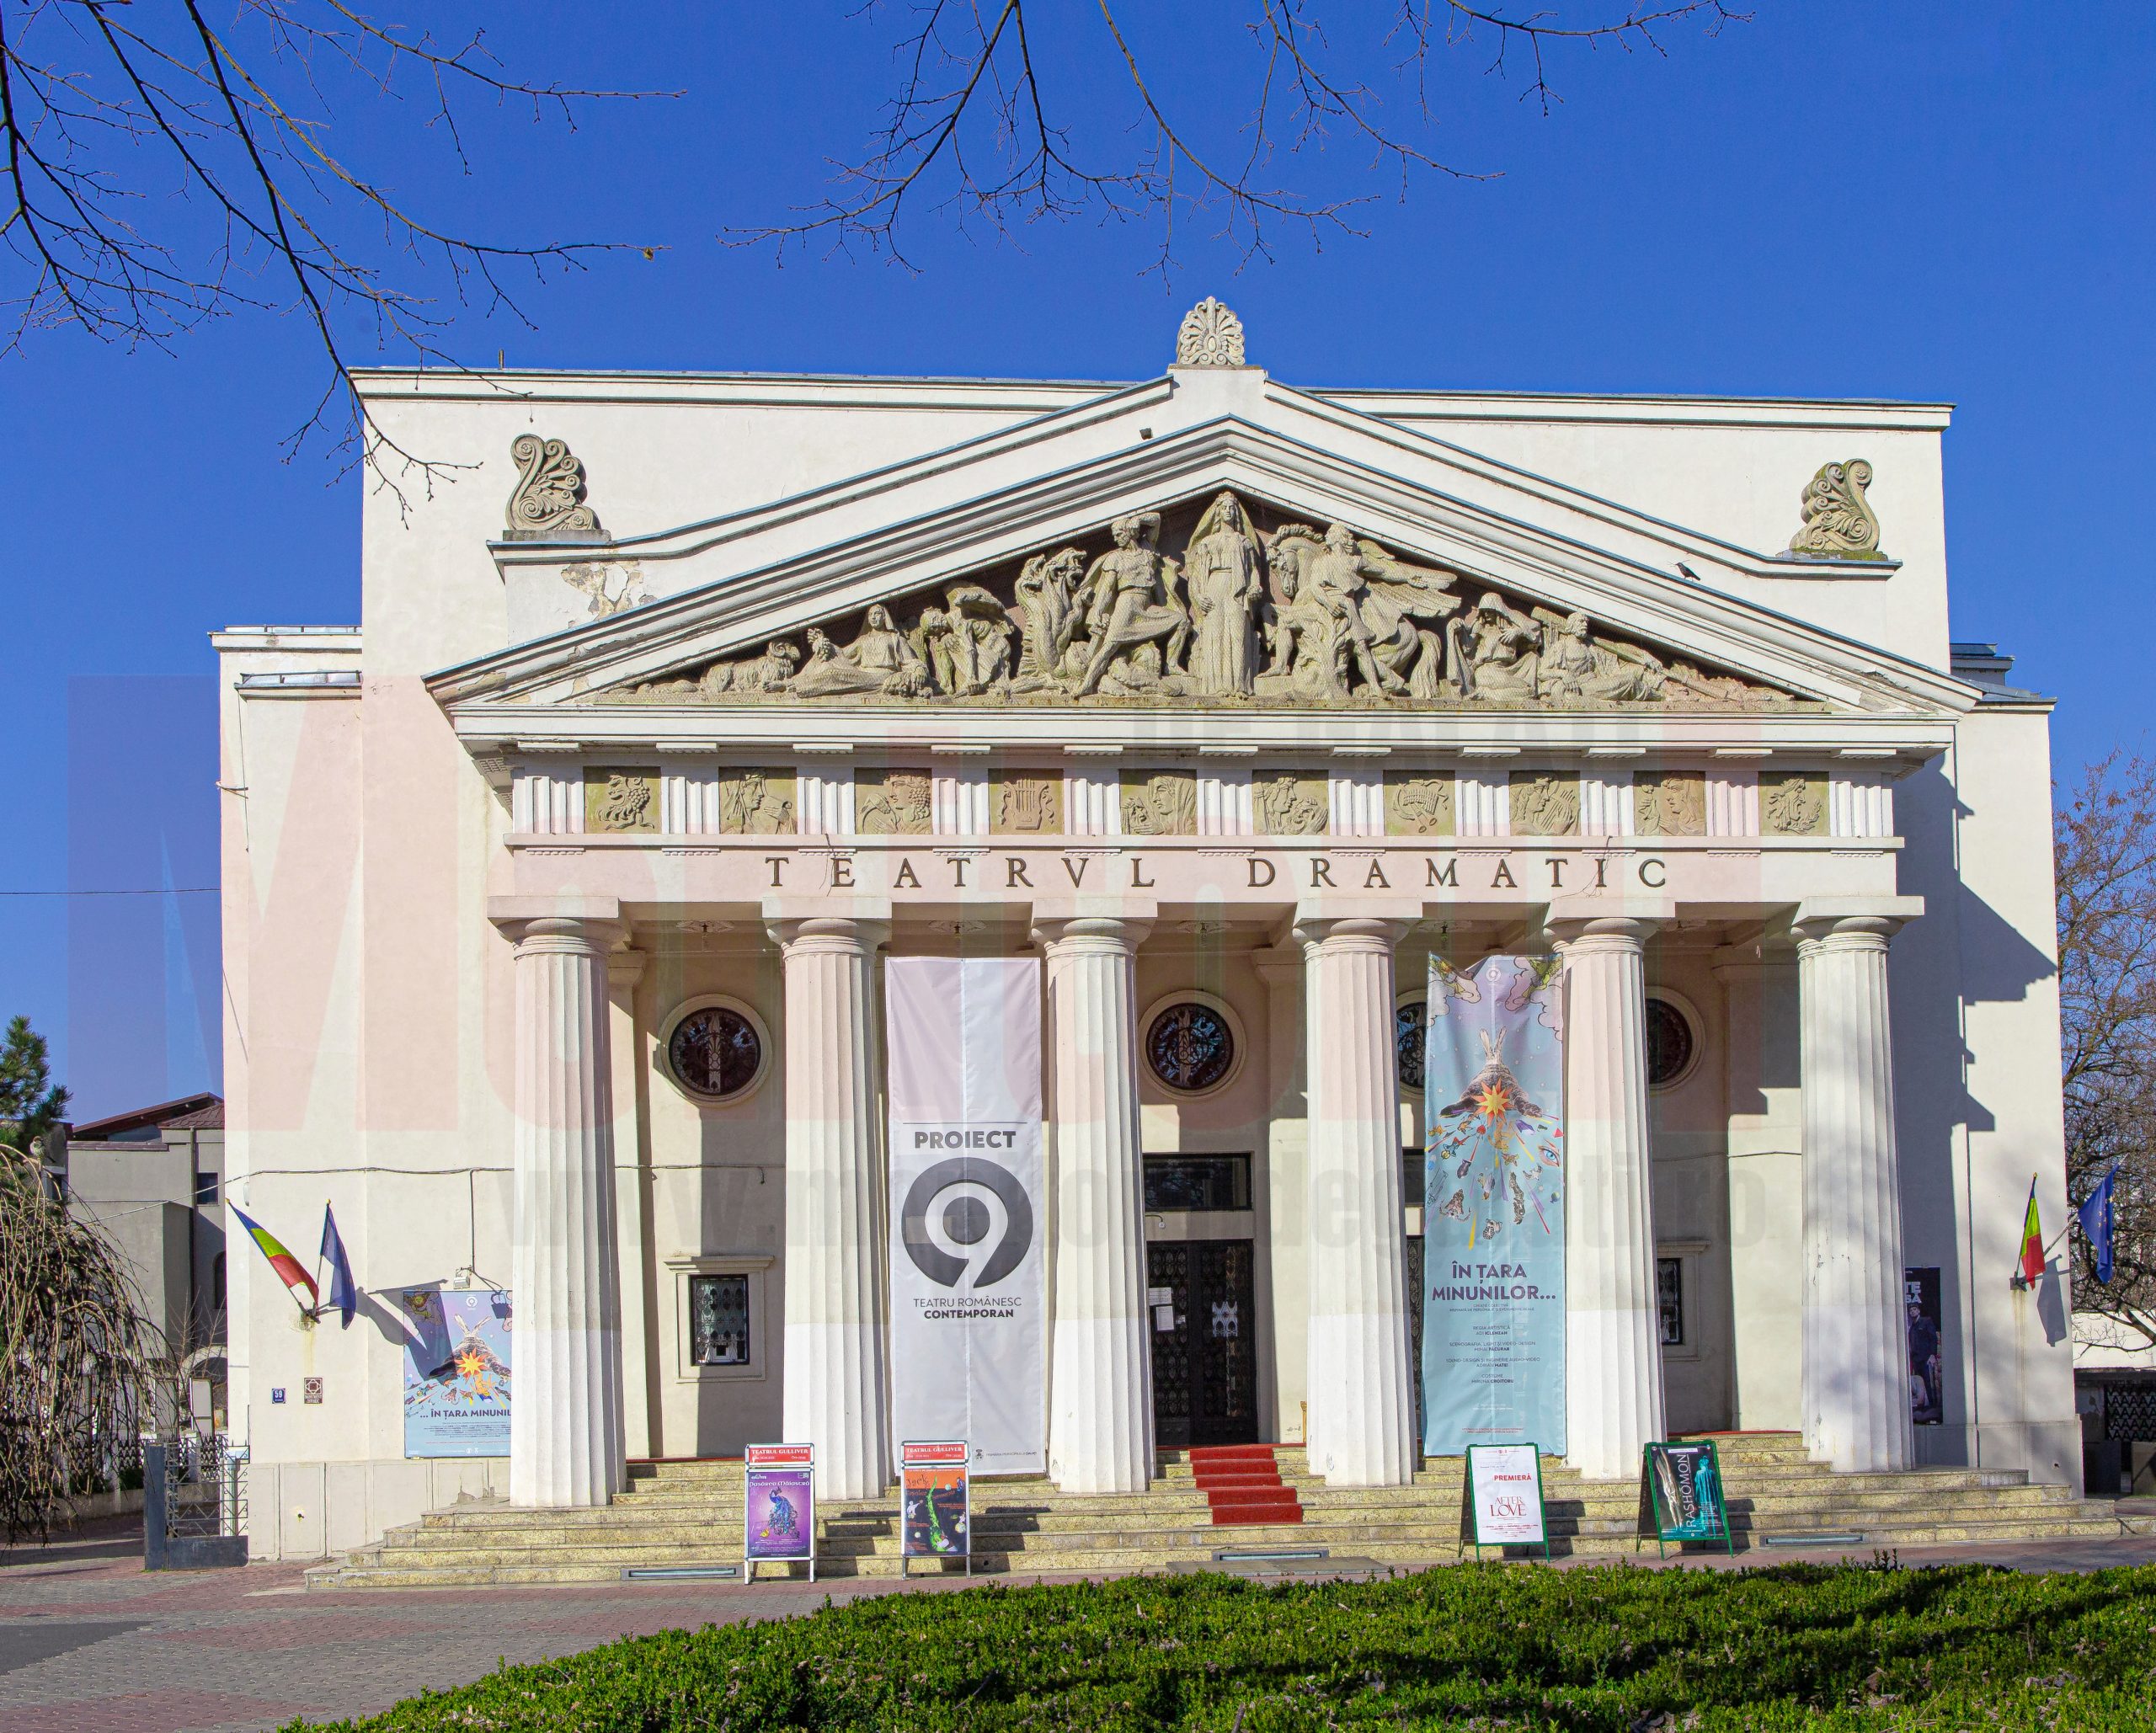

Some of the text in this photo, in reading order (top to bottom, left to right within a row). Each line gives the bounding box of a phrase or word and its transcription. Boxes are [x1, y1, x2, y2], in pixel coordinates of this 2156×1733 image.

[765, 856, 1667, 889] TEATRVL DRAMATIC
[915, 1130, 1017, 1149] PROIECT
[1451, 1261, 1527, 1284] ÎN ȚARA
[1432, 1285, 1556, 1301] MINUNILOR...
[914, 1296, 1022, 1308] TEATRU ROMÂNESC
[924, 1309, 1014, 1320] CONTEMPORAN
[430, 1408, 441, 1417] ÎN
[443, 1410, 469, 1420] ȚARA
[1494, 1473, 1532, 1481] PREMIERĂ
[1495, 1496, 1525, 1506] AFTER
[1490, 1504, 1527, 1517] LOVE
